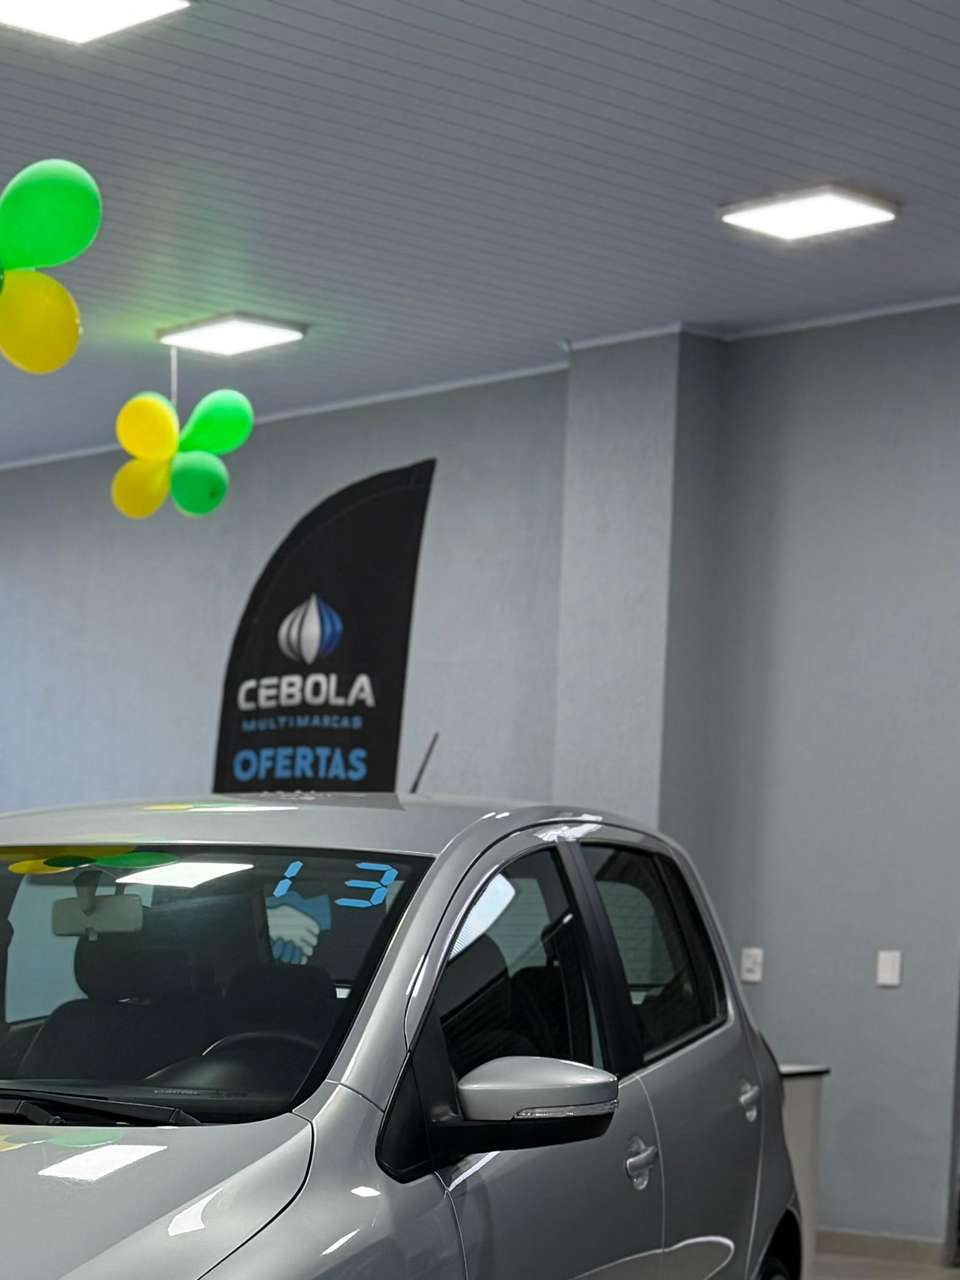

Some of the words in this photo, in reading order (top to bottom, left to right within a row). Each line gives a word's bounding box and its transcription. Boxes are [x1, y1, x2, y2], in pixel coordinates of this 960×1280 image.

[237, 672, 376, 711] CEBOLA
[241, 714, 363, 732] MULTIMARCAS
[232, 746, 368, 782] OFERTAS
